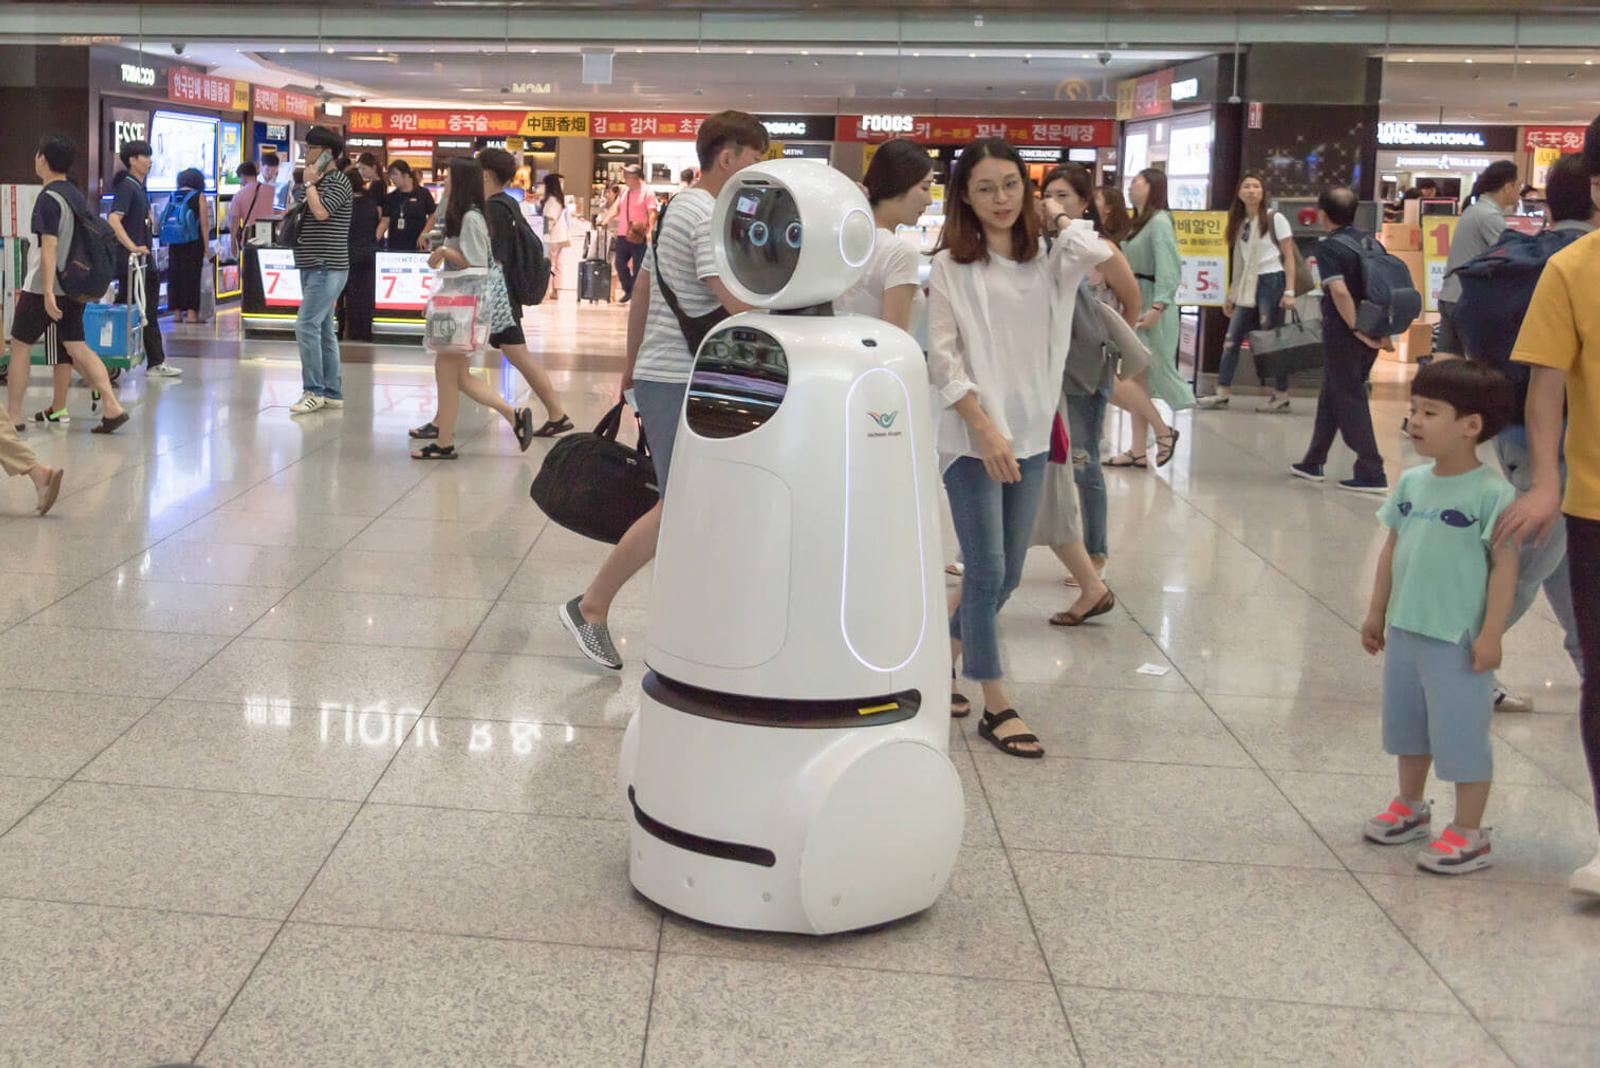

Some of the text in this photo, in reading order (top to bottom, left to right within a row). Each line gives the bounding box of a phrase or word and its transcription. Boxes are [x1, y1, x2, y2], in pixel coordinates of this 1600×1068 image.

[390, 114, 417, 130] 와인
[448, 115, 488, 132] 중국술
[527, 116, 586, 132] 中国香烟
[594, 117, 607, 134] 김
[630, 118, 657, 134] 김치
[762, 121, 807, 134] OGNAC
[862, 115, 914, 131] FOODS
[1032, 124, 1095, 142] 전문매장
[1526, 131, 1585, 149] 乐天免
[1173, 219, 1221, 235] 배할인
